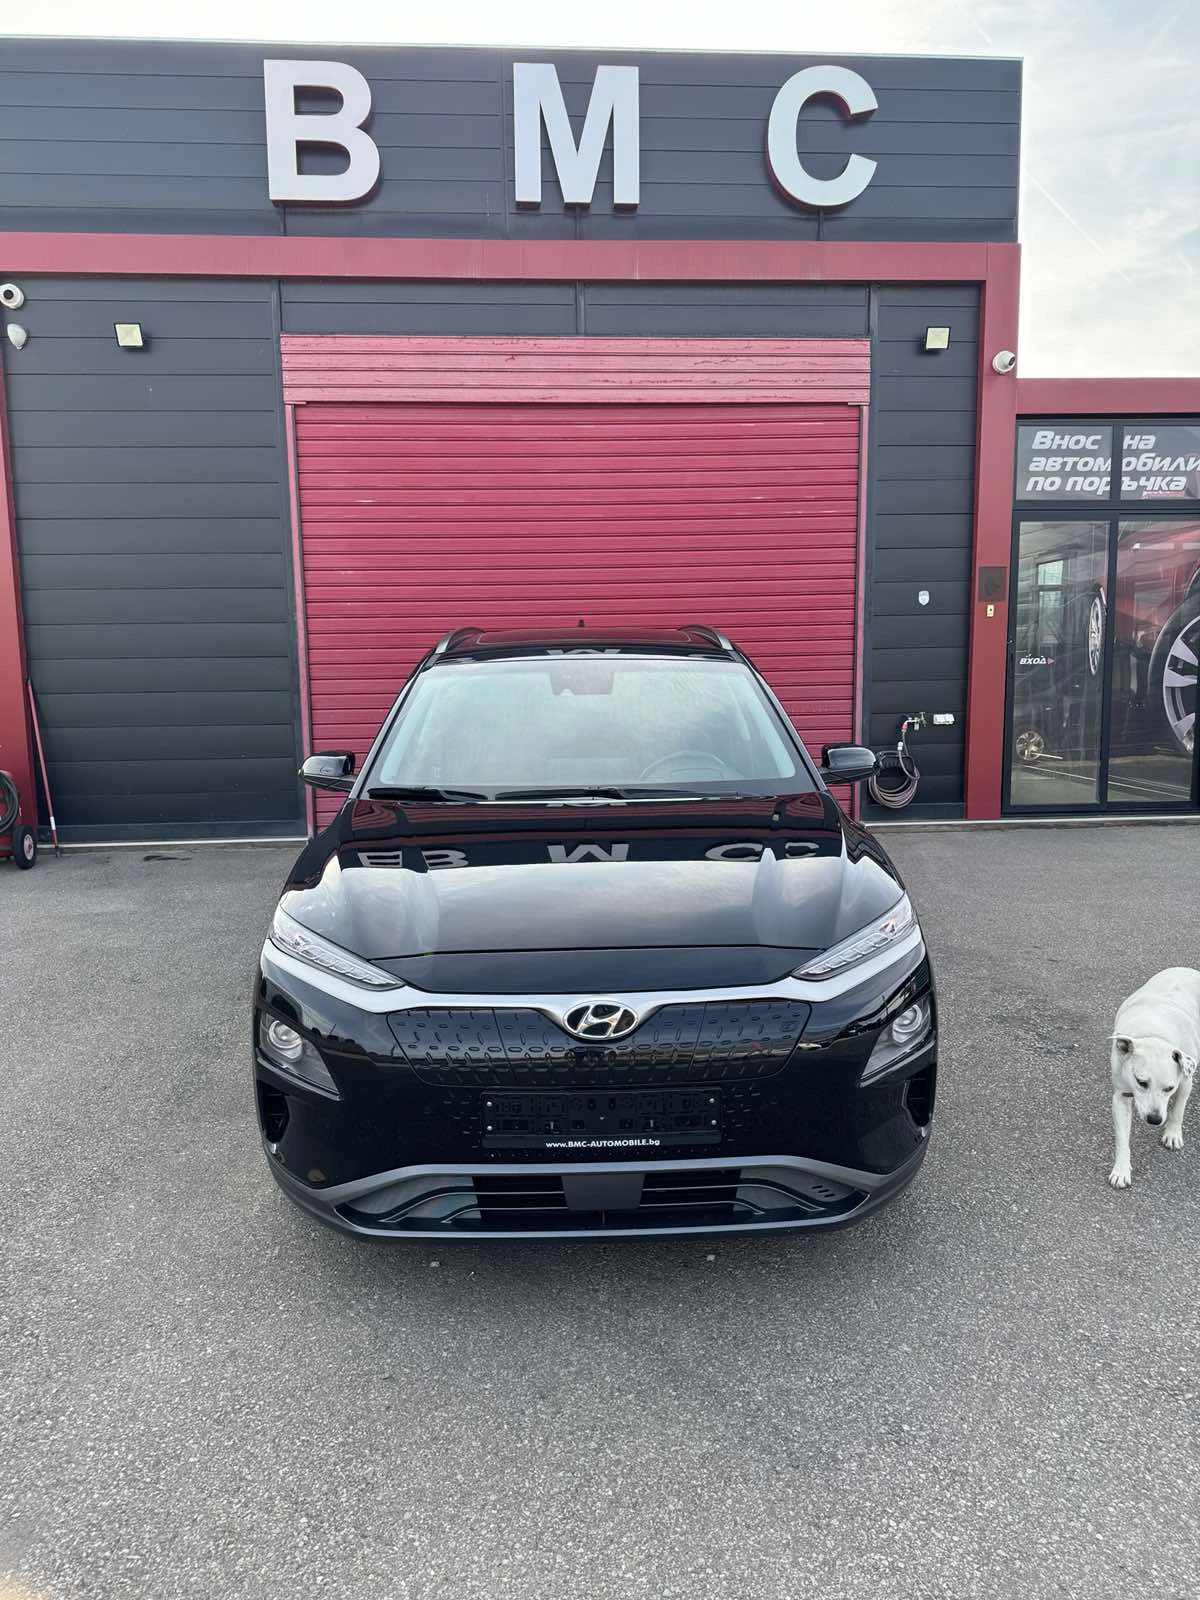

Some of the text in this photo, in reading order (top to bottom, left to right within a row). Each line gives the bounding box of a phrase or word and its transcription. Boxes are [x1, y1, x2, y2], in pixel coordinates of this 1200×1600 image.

[1031, 430, 1157, 450] Внос на
[1025, 476, 1062, 491] по
[545, 1138, 661, 1148] www.BMC-AUTOMOBILE.bg
